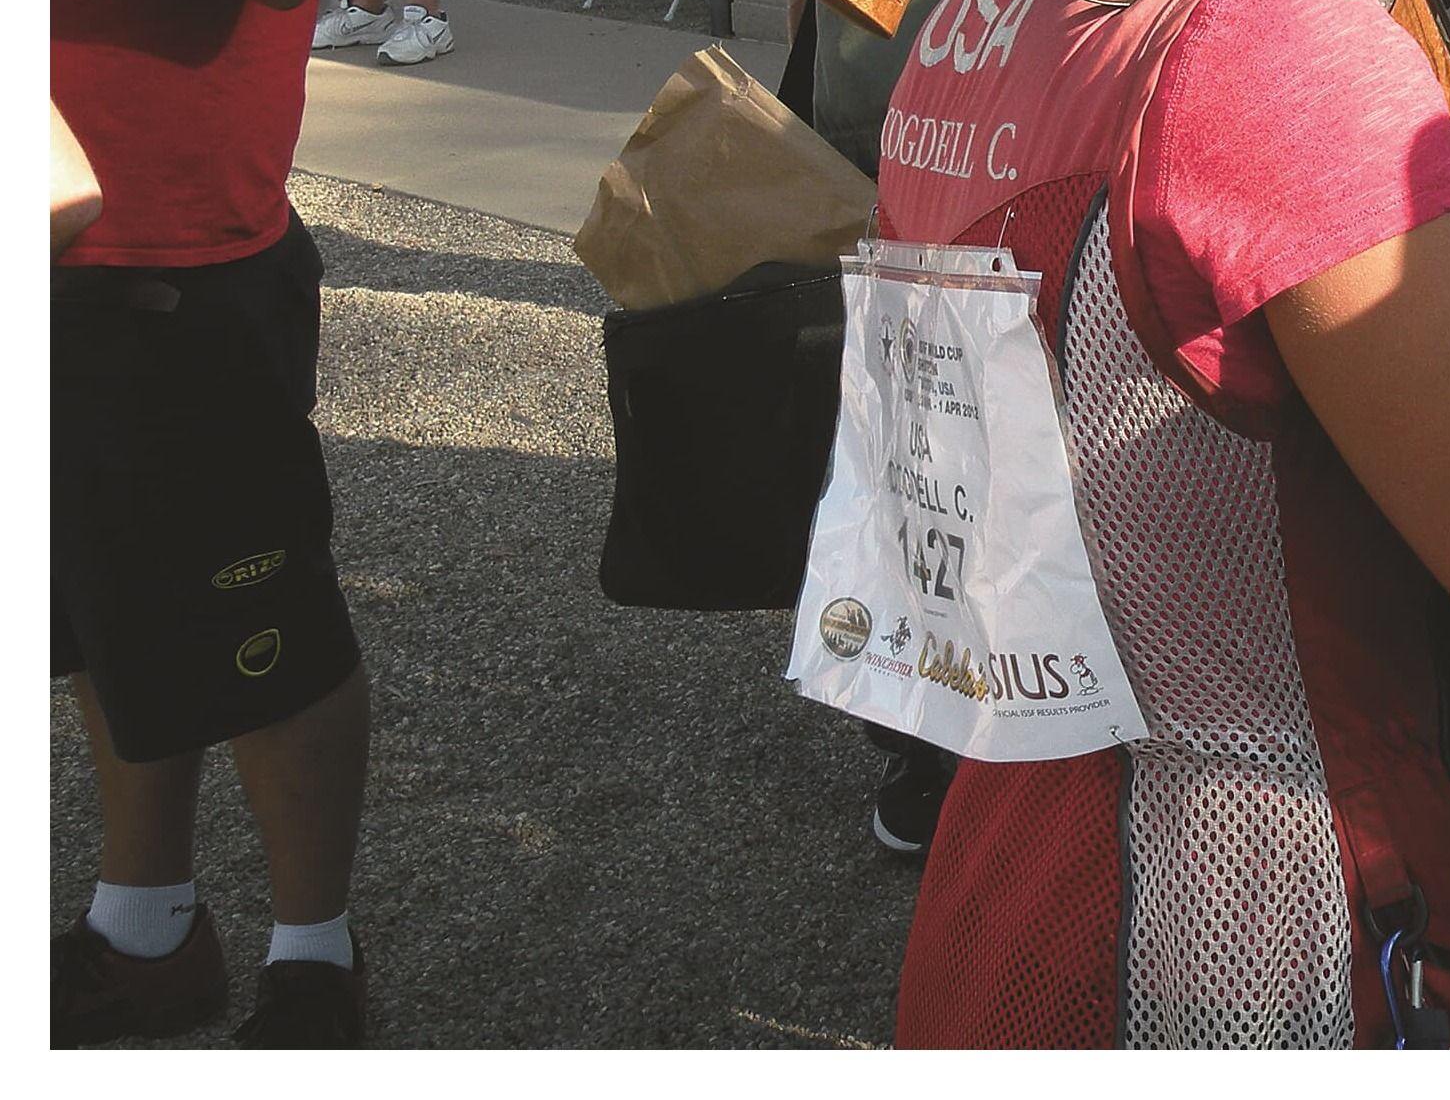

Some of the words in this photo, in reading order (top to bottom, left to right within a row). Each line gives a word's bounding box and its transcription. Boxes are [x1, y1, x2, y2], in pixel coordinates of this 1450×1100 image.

[881, 107, 976, 179] COGDELL
[987, 123, 1018, 181] C.
[947, 346, 963, 362] CUP
[938, 382, 955, 397] USA
[945, 401, 961, 417] APR
[962, 403, 979, 419] 2012
[909, 421, 932, 463] USA
[955, 485, 974, 523] C.
[898, 517, 966, 601] 1427
[865, 652, 913, 678] WINCHESTER
[989, 653, 1070, 701] SIUS
[1036, 707, 1068, 717] RESULTS
[1069, 699, 1110, 713] PROVIDER
